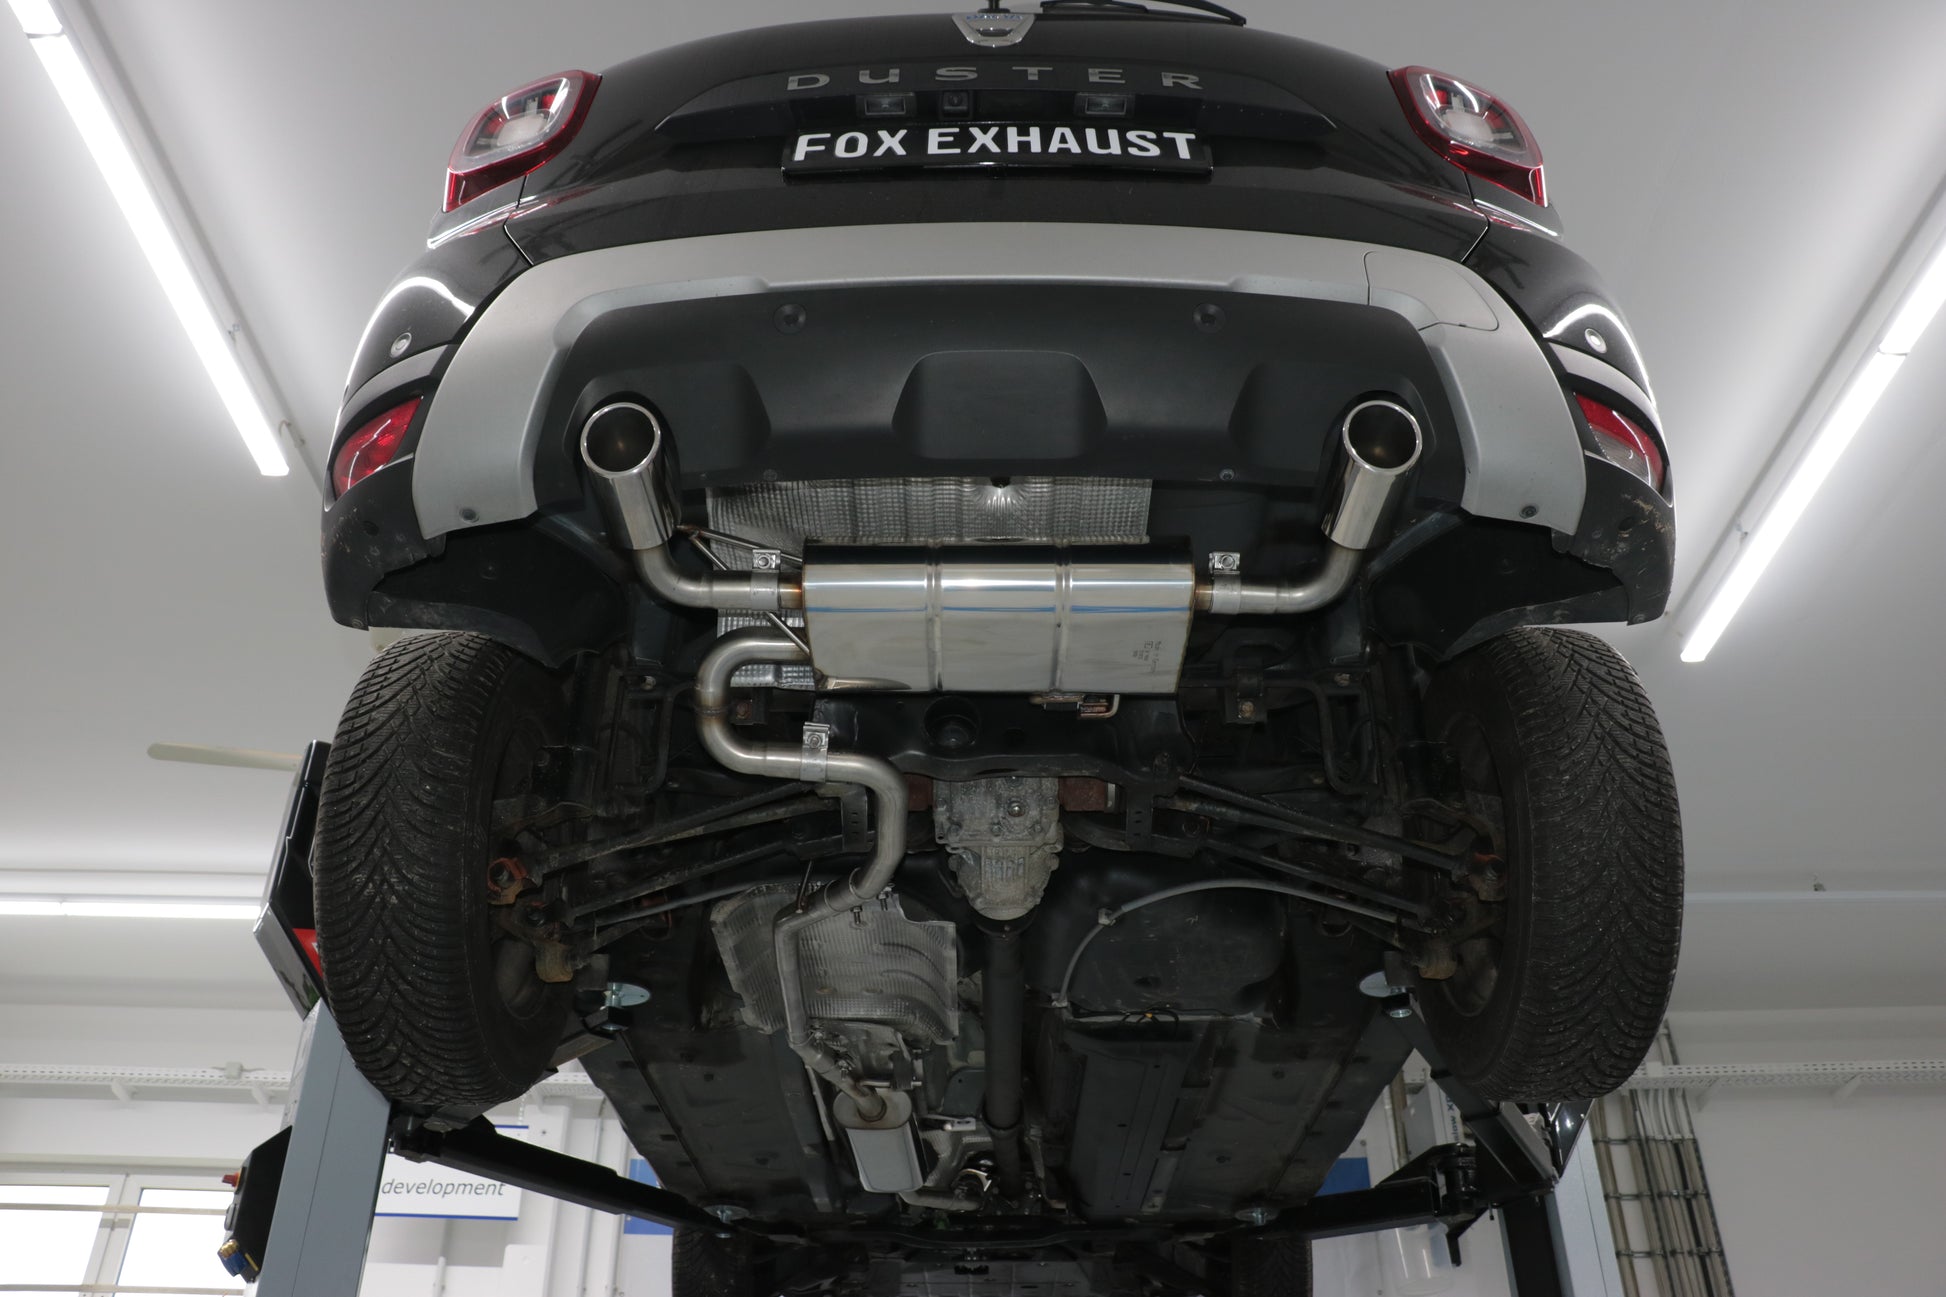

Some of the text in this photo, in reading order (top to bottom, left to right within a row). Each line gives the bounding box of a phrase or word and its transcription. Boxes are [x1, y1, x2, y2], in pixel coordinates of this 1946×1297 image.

[787, 66, 1203, 91] DUSTER
[794, 126, 1196, 161] FOX EXHAUST
[381, 1178, 506, 1198] development
